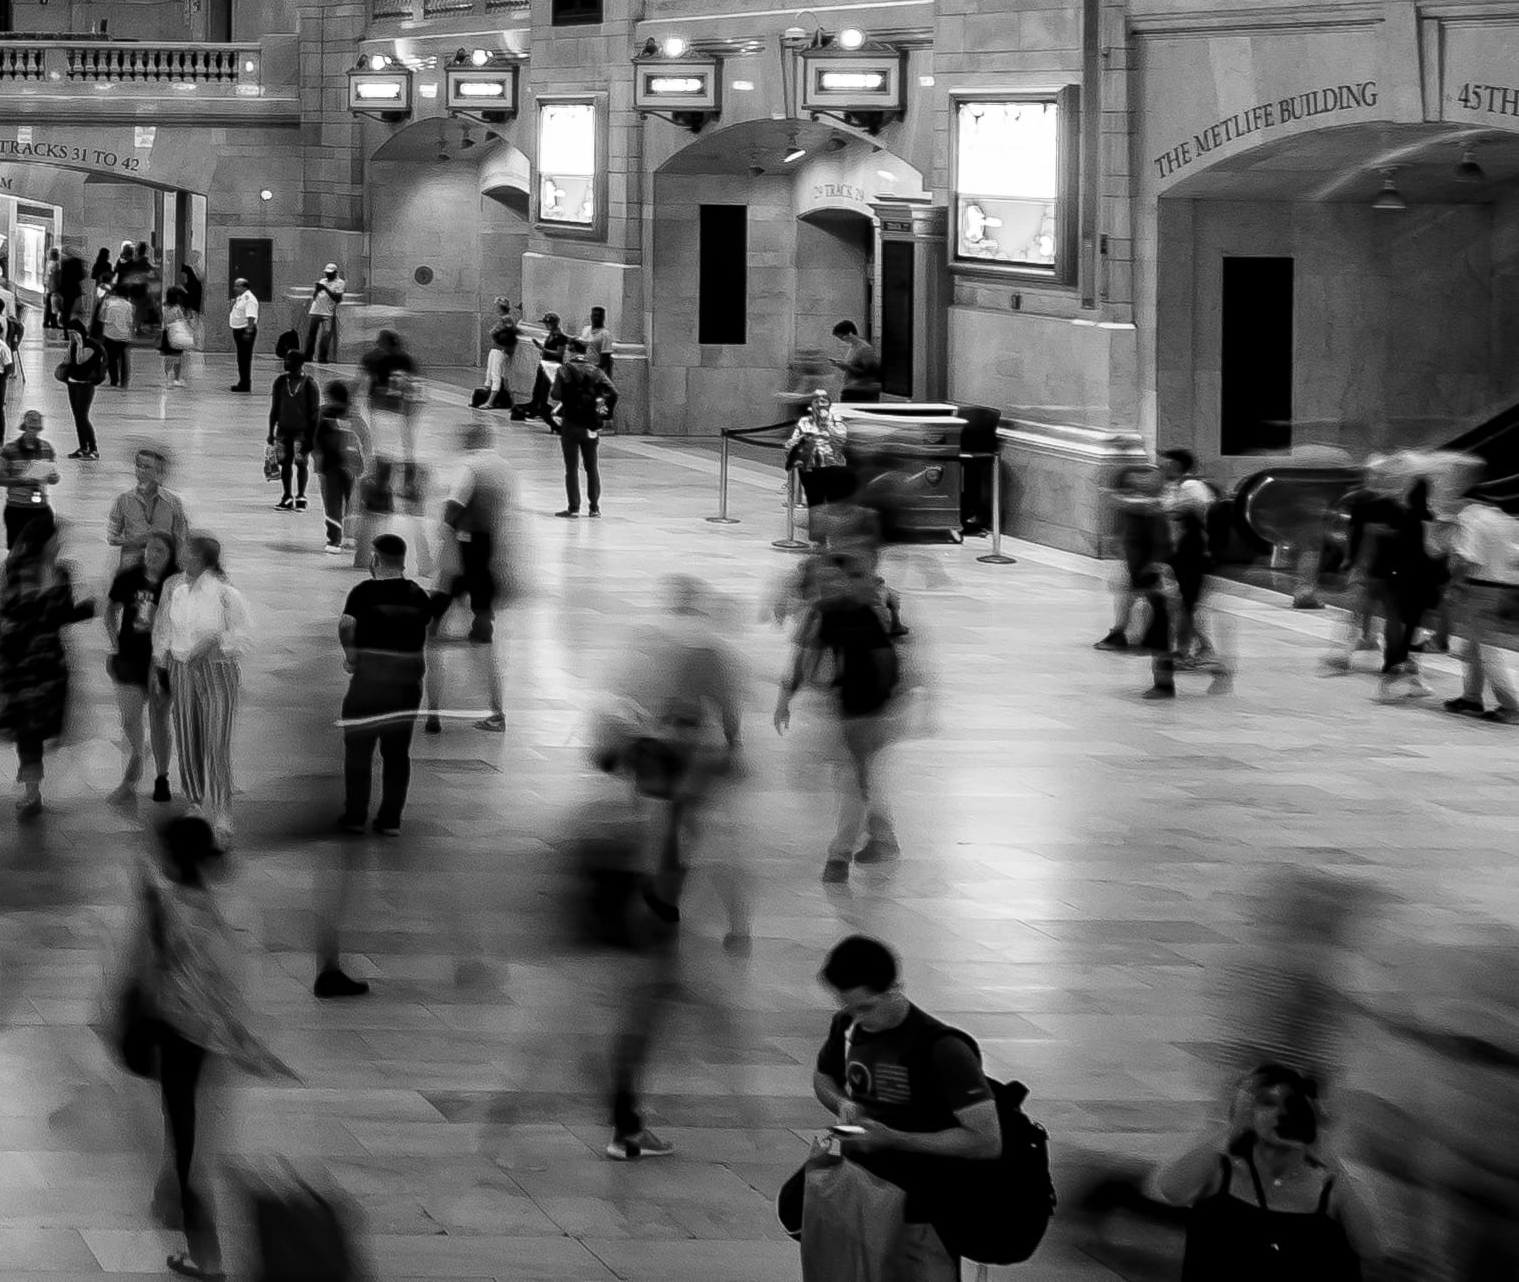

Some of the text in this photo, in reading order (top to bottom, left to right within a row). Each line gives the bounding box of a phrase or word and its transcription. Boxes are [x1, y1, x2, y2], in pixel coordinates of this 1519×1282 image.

[1458, 83, 1519, 117] 45TH
[1154, 81, 1379, 179] THE METLIFE BUILDING
[72, 148, 88, 162] 31
[93, 150, 117, 166] TO
[121, 157, 140, 171] 42
